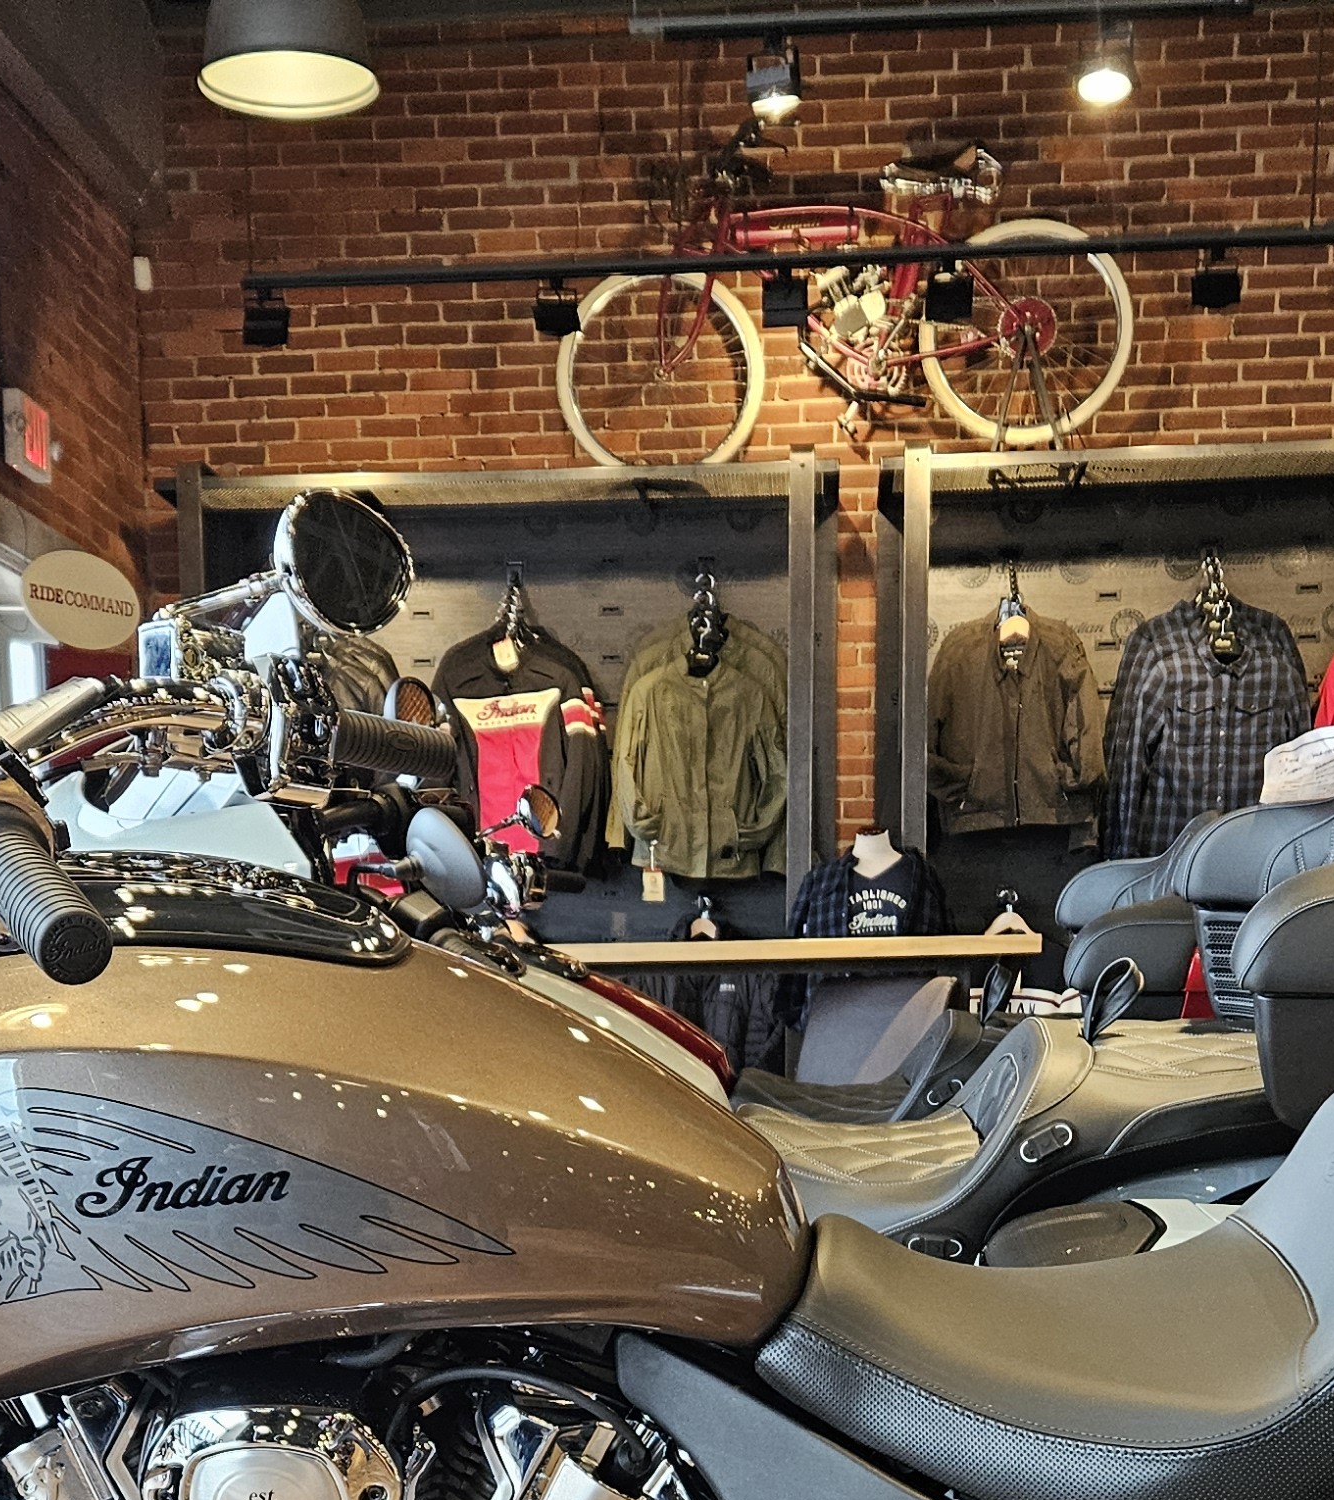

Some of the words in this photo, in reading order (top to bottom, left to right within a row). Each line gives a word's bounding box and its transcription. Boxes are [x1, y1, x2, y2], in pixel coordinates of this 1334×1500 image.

[477, 700, 537, 722] Indian
[849, 889, 907, 909] TABLISHED
[848, 912, 898, 930] Indian
[74, 1156, 291, 1219] Indian
